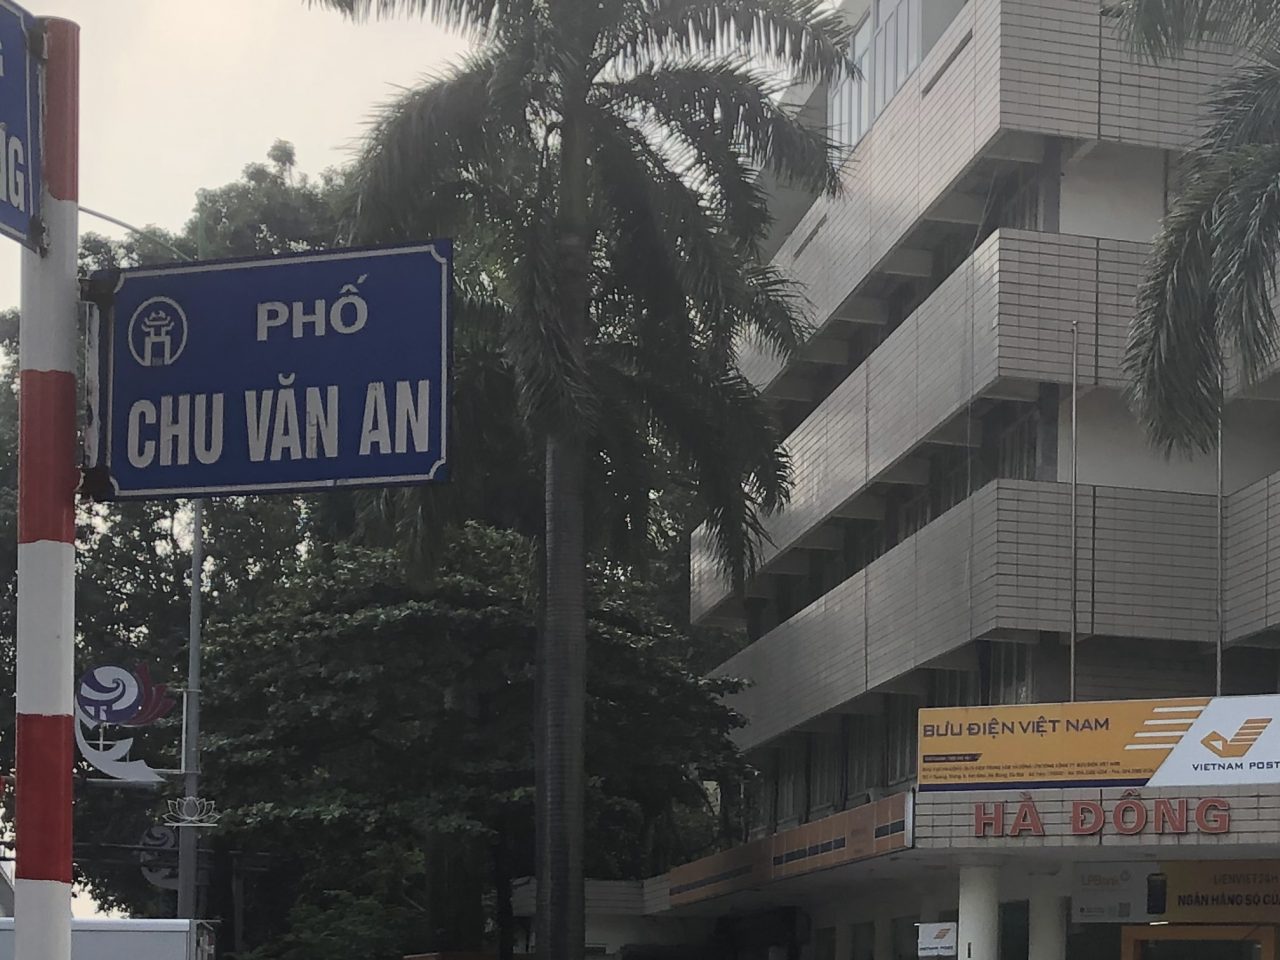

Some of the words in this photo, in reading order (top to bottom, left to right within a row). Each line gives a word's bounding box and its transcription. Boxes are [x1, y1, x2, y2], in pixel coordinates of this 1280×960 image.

[257, 273, 369, 341] PHỐ
[127, 392, 225, 469] CHU
[244, 372, 339, 462] VĂN
[359, 379, 431, 456] AN
[923, 720, 963, 738] BƯU
[966, 717, 1015, 739] ĐIỆN
[1018, 715, 1061, 738] VIỆT
[1066, 717, 1110, 732] NAM
[1192, 762, 1244, 771] VIETNAM
[1249, 761, 1280, 770] POST
[974, 791, 1045, 837] HÀ
[1070, 788, 1231, 835] ĐÔNG
